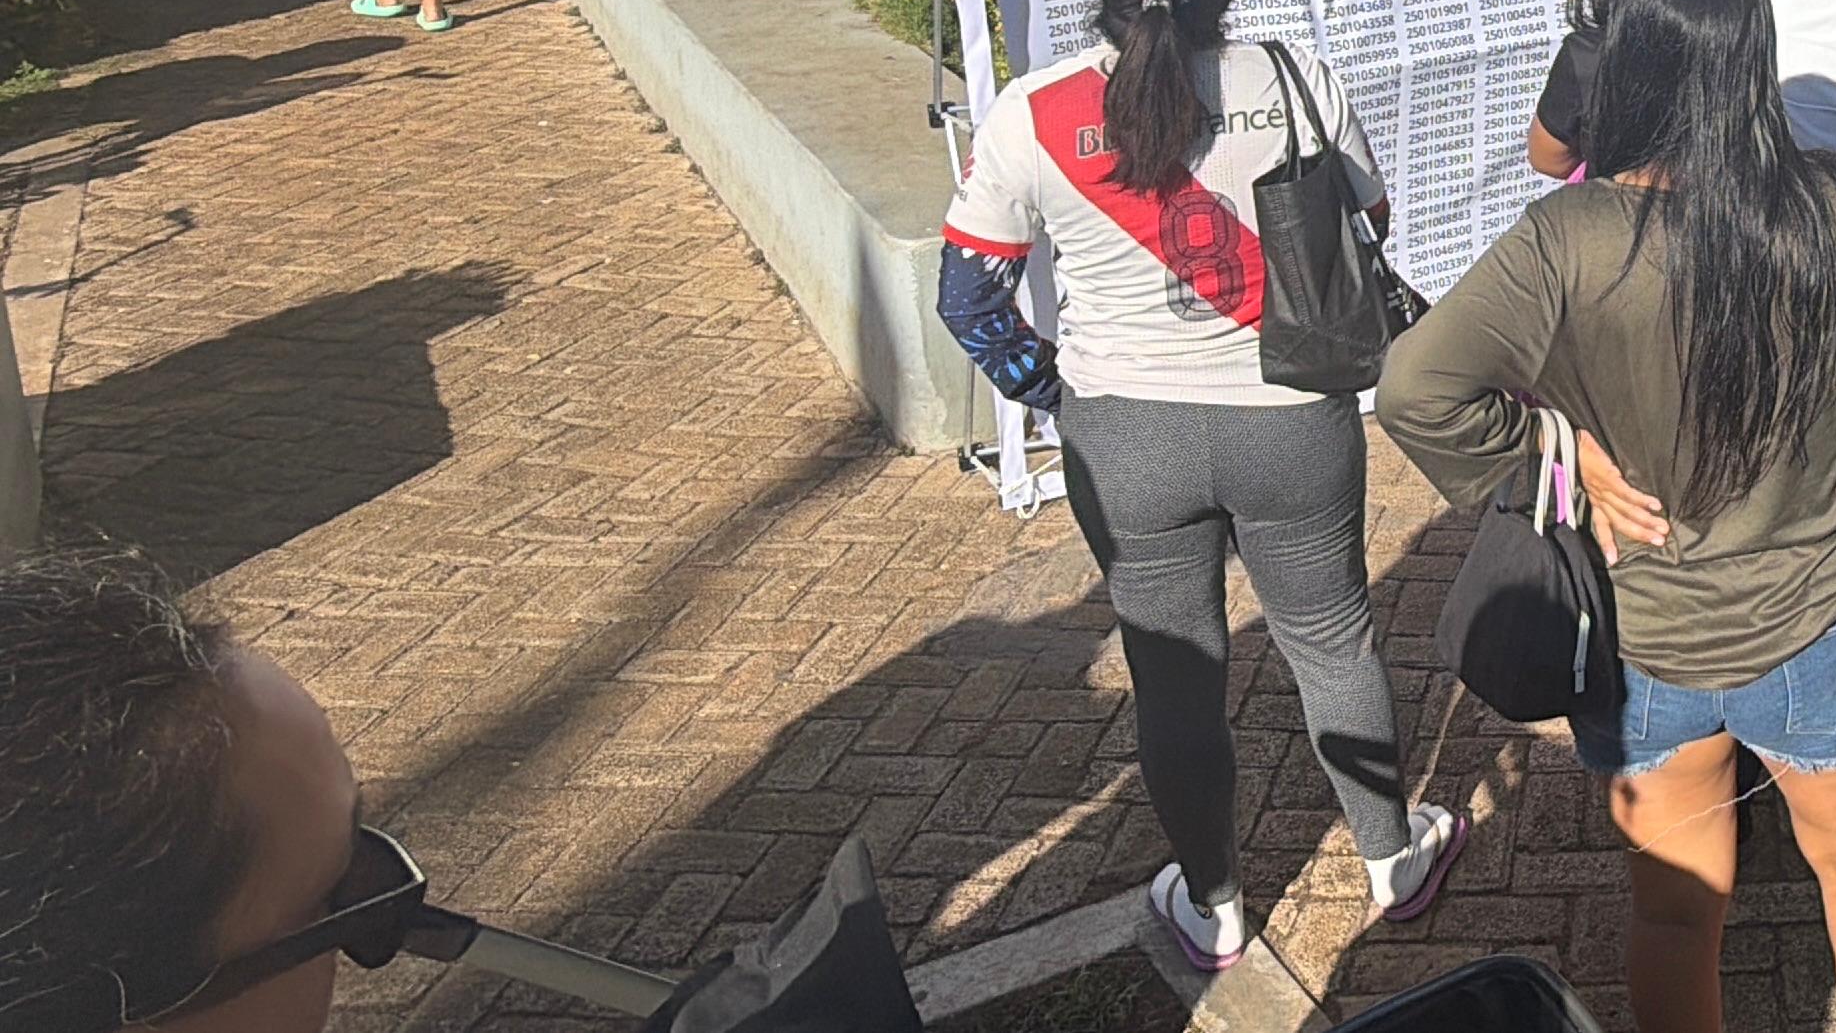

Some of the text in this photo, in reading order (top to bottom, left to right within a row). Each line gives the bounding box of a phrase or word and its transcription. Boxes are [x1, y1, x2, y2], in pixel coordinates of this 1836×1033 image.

[1409, 34, 1475, 55] 2501060088
[1410, 77, 1476, 100] 2501047915
[1408, 93, 1476, 115] 2501047927
[1408, 108, 1475, 130] 2501053787
[1407, 153, 1474, 175] 2501053931
[1407, 167, 1474, 189] 2501043630
[1407, 224, 1473, 248] 2501048300
[1159, 190, 1246, 321] 8
[1408, 239, 1474, 265] 2501046995
[1410, 254, 1475, 280] 2501023393
